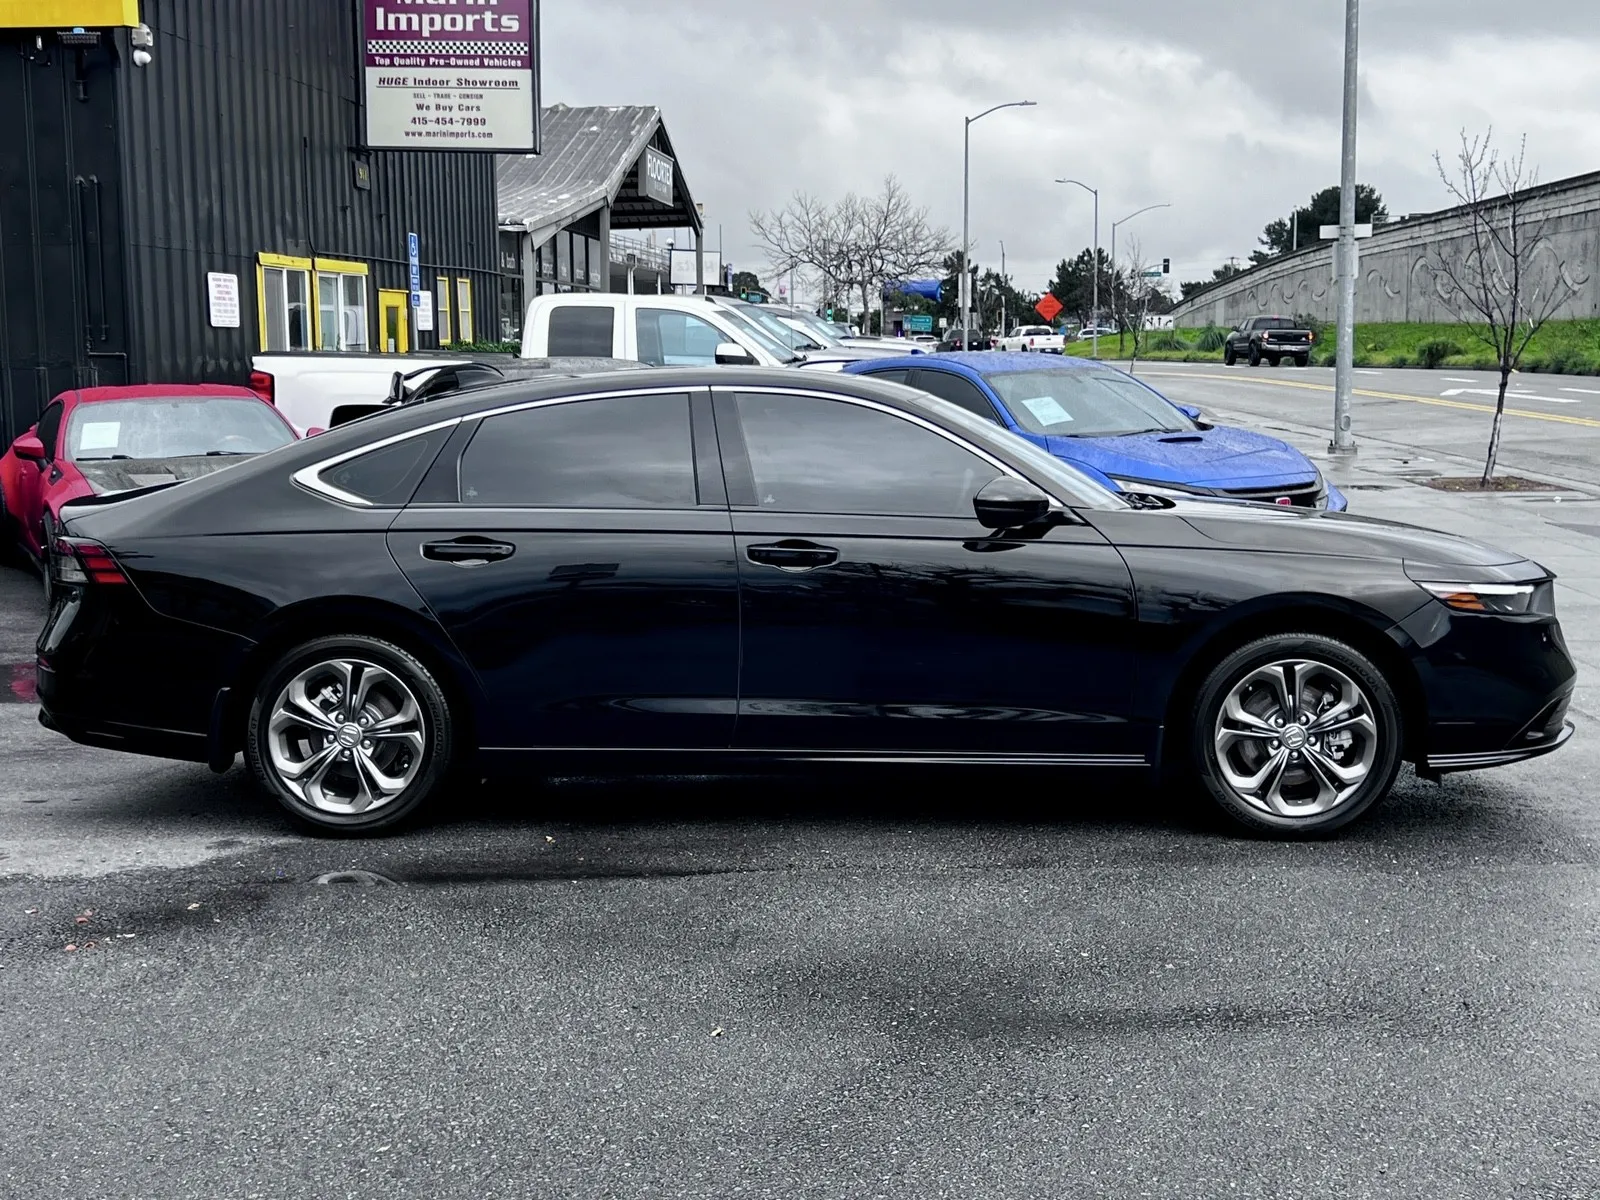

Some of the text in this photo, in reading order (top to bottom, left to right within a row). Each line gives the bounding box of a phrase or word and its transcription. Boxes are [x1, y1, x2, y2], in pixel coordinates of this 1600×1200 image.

[375, 7, 520, 37] Imports
[374, 56, 522, 67] Top Quality Pre-Owned Vehicles
[378, 77, 518, 87] HUGE Indoor Showroom
[416, 103, 481, 112] We Buy Cars
[411, 116, 487, 126] 415-454-7999
[404, 130, 493, 139] www.marinimports.com
